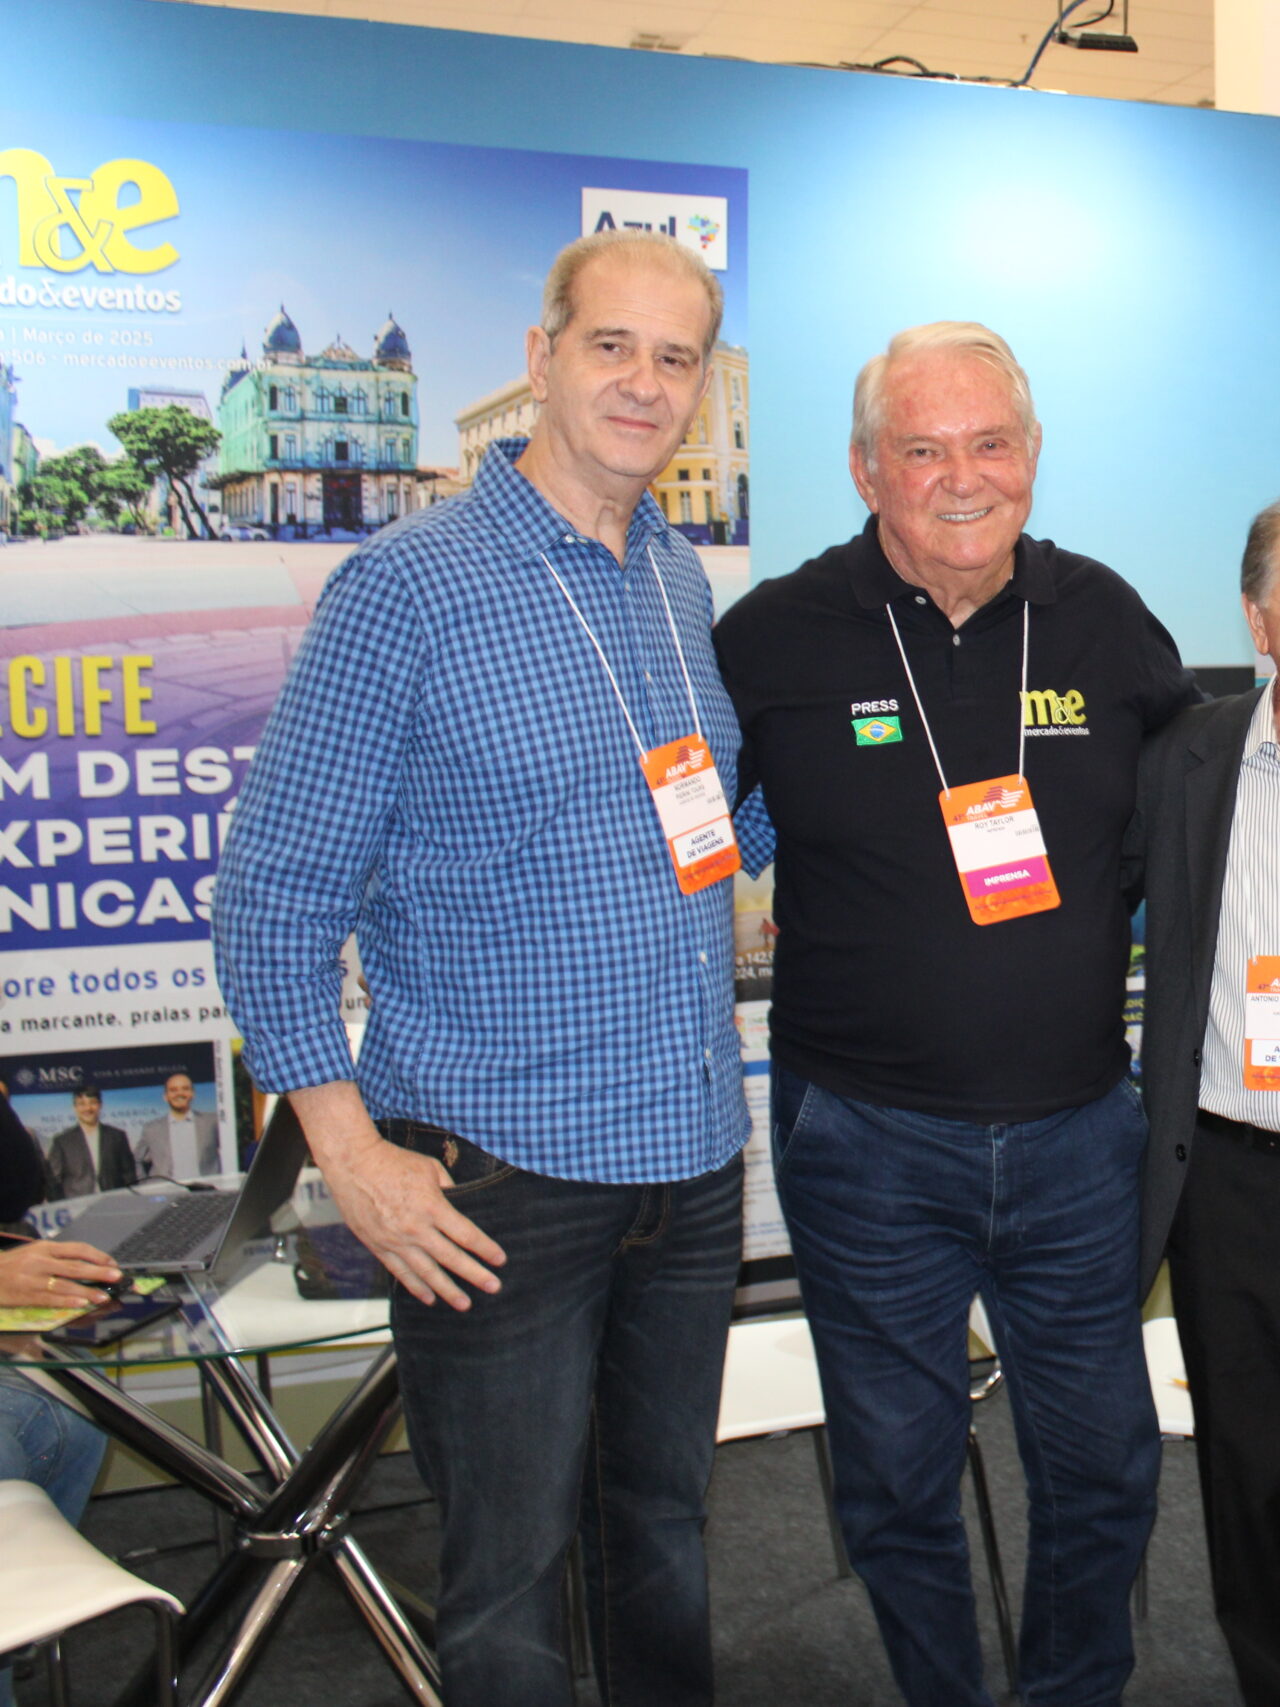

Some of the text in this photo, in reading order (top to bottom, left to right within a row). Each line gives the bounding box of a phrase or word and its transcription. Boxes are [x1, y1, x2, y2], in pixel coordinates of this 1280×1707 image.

[83, 329, 104, 344] de
[109, 331, 153, 346] 2025
[0, 654, 157, 738] CIFE
[851, 699, 900, 716] PRESS
[1019, 688, 1087, 725] m&e
[965, 800, 996, 816] ABAV
[989, 815, 1014, 826] TAYLOR
[690, 829, 716, 846] AGENTE
[686, 837, 725, 859] DE VIAGENS
[983, 868, 1031, 887] IMPRENSA
[69, 967, 159, 995] todos
[172, 966, 207, 989] os
[1250, 995, 1279, 1003] ANTONIO
[131, 1004, 191, 1027] praias
[38, 1065, 84, 1082] MSC
